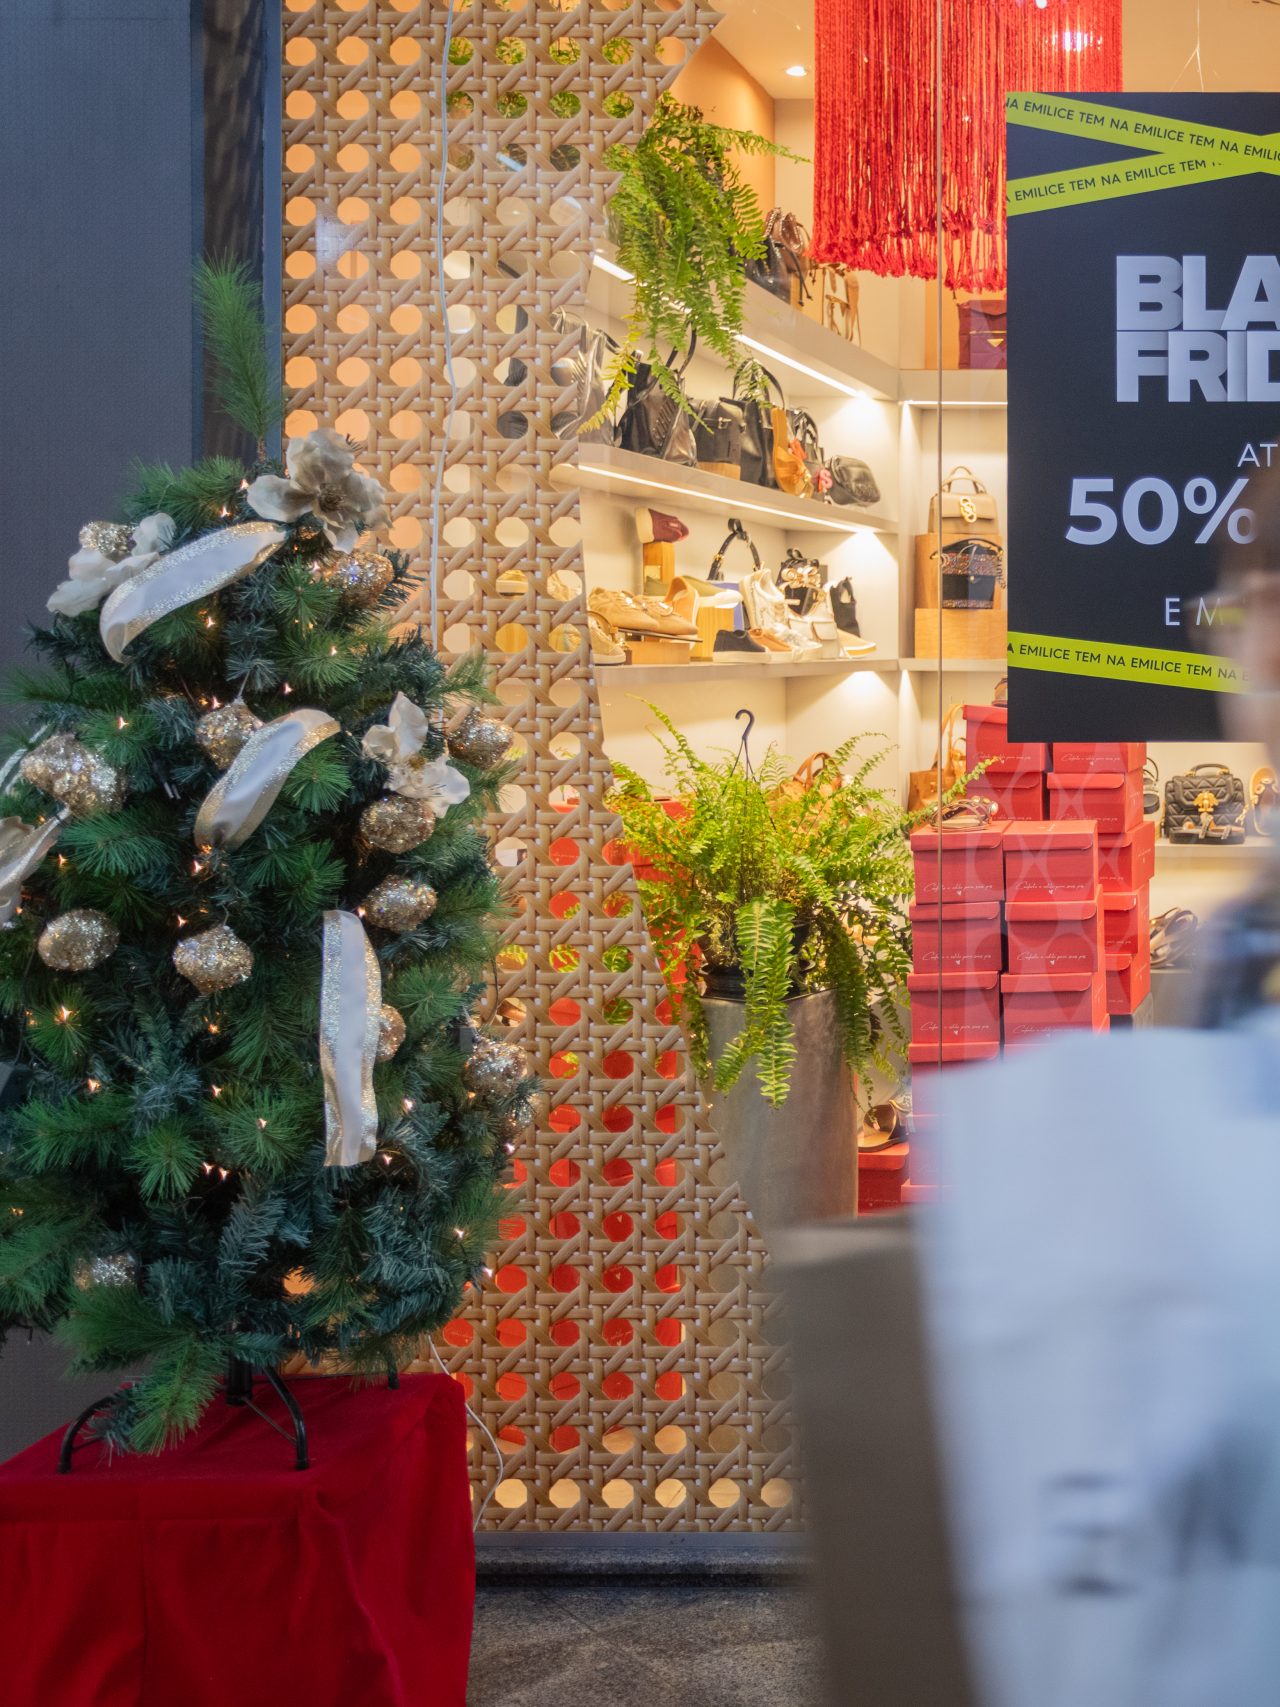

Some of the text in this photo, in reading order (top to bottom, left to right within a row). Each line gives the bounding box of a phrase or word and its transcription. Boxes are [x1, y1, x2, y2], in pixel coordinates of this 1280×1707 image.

[1024, 101, 1074, 120] EMILICE
[1079, 112, 1105, 126] TEM
[1110, 118, 1129, 131] NA
[1134, 123, 1184, 142] EMILICE
[1189, 133, 1215, 148] TEM
[1220, 140, 1239, 153] NA
[1014, 183, 1066, 202] EMILICE
[1069, 177, 1096, 192] TEM
[1101, 173, 1121, 186] NA
[1125, 163, 1176, 182] EMILICE
[1179, 159, 1206, 172] TEM
[1065, 477, 1257, 545] 50%
[1019, 644, 1070, 660] EMILICE
[1075, 650, 1101, 664] TEM
[1106, 655, 1126, 667] NA
[1130, 657, 1181, 673] EMILICE
[1186, 663, 1213, 677] TEM
[1217, 668, 1237, 680] NA
